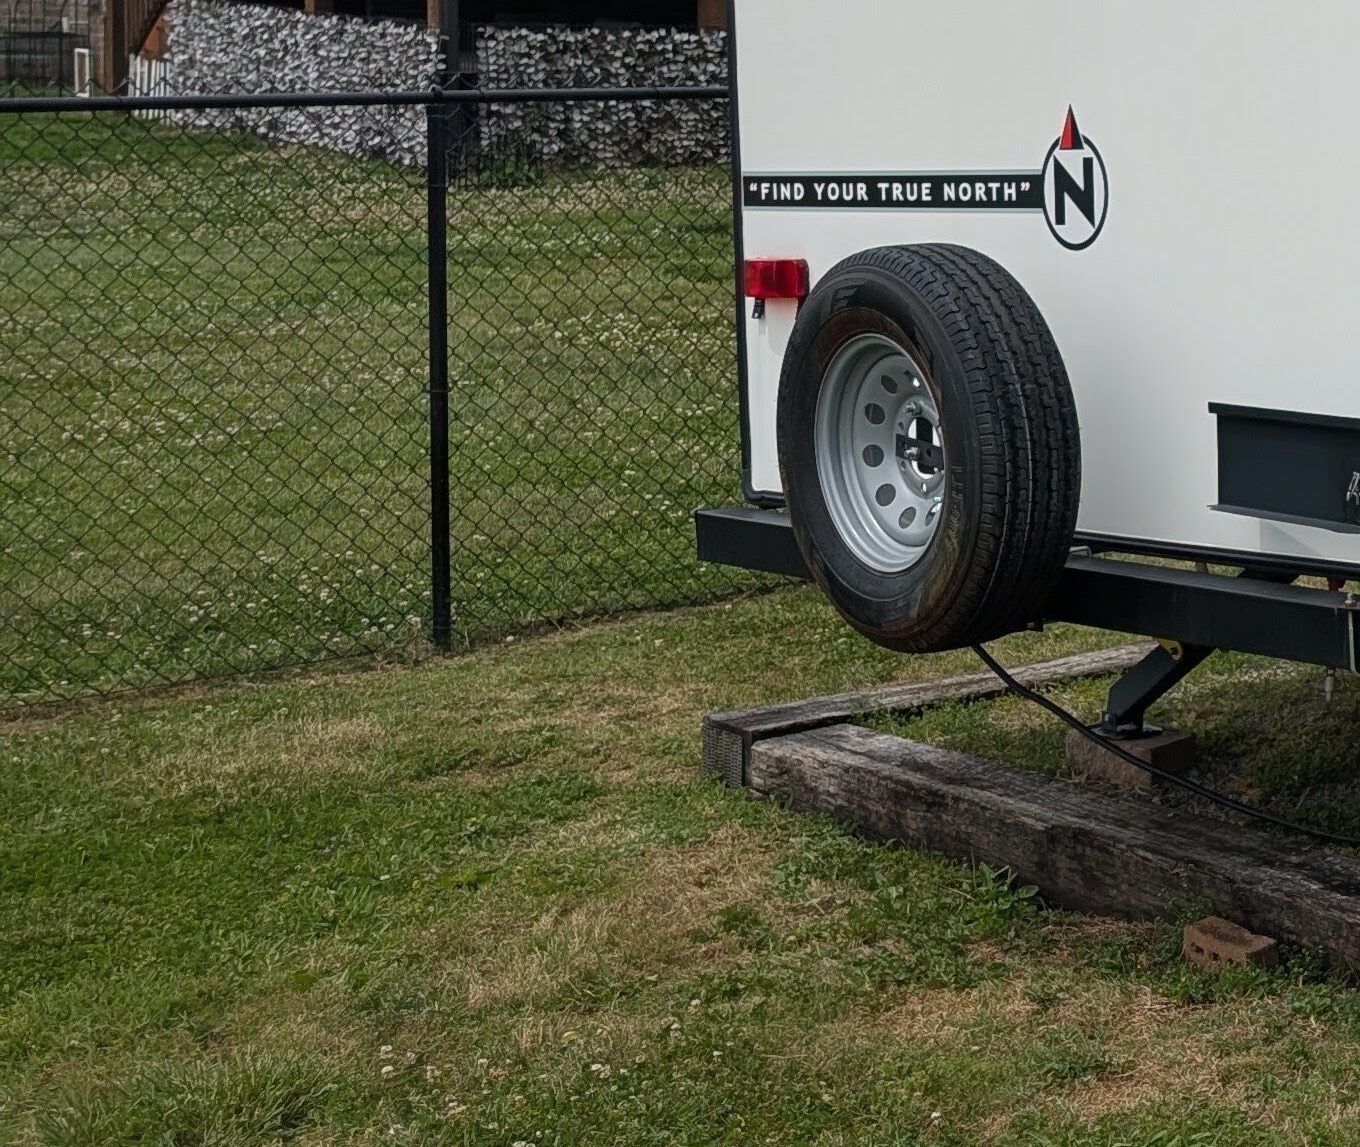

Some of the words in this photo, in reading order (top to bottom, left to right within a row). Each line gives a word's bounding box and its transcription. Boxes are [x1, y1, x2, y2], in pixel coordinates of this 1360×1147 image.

[749, 182, 805, 201] “FIND
[813, 182, 868, 201] YOUR
[877, 182, 931, 202] TRUE
[943, 181, 1031, 203] NORTH”
[1053, 154, 1096, 229] N
